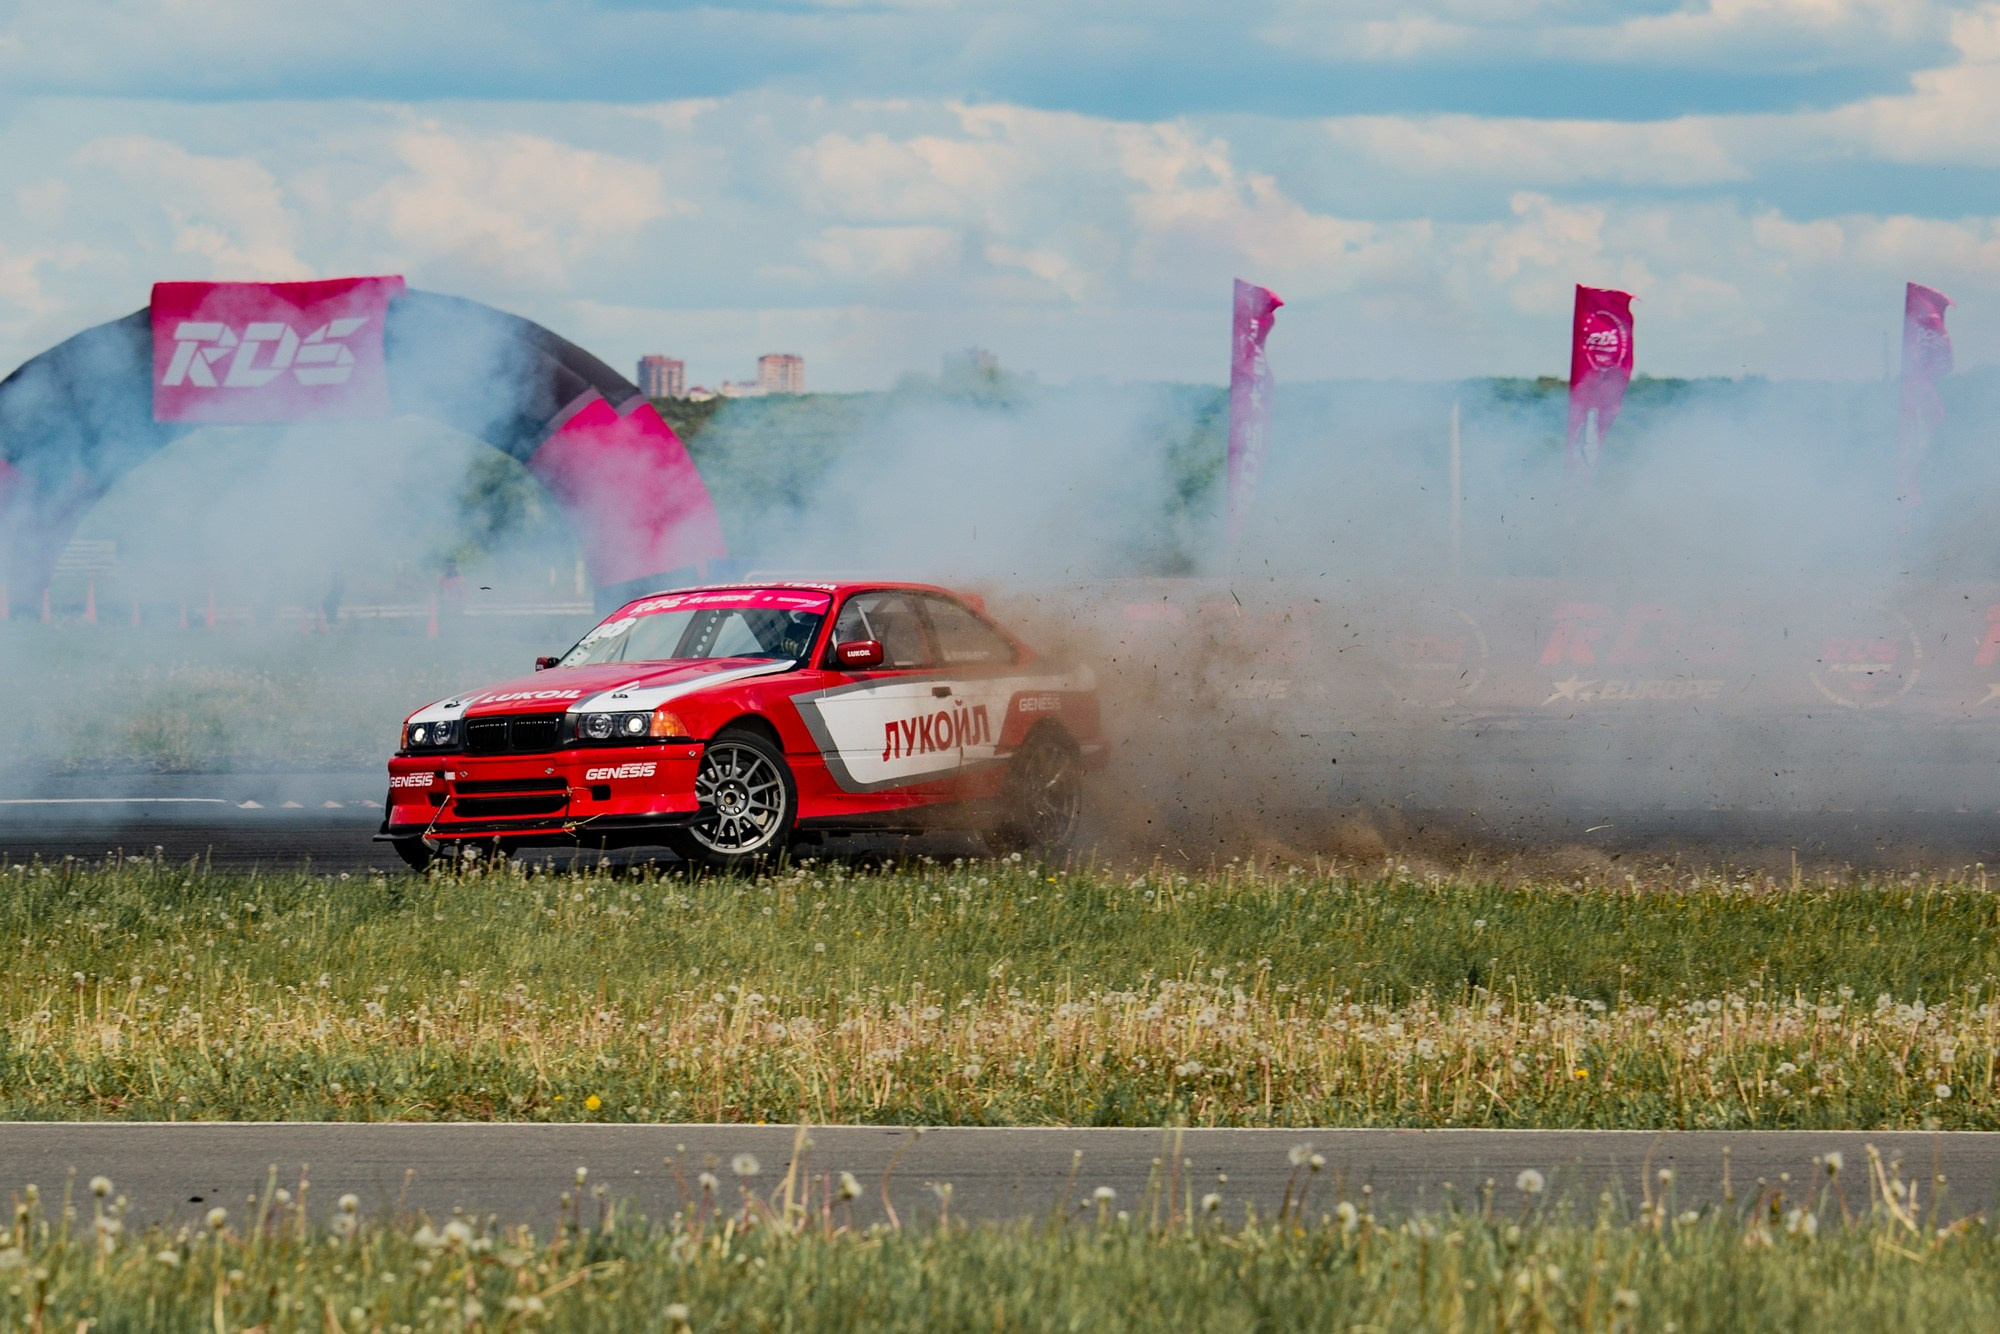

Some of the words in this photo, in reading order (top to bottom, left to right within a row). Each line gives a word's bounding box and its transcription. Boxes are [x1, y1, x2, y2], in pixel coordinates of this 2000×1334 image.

[1585, 329, 1619, 346] RDS
[162, 317, 370, 387] RDS
[628, 596, 690, 615] RDS
[480, 689, 581, 704] LUKOIL
[1600, 679, 1726, 699] EUROPE
[1019, 697, 1061, 712] GENESIS
[882, 699, 991, 762] ЛУКОЙЛ
[586, 765, 657, 780] GENESIS
